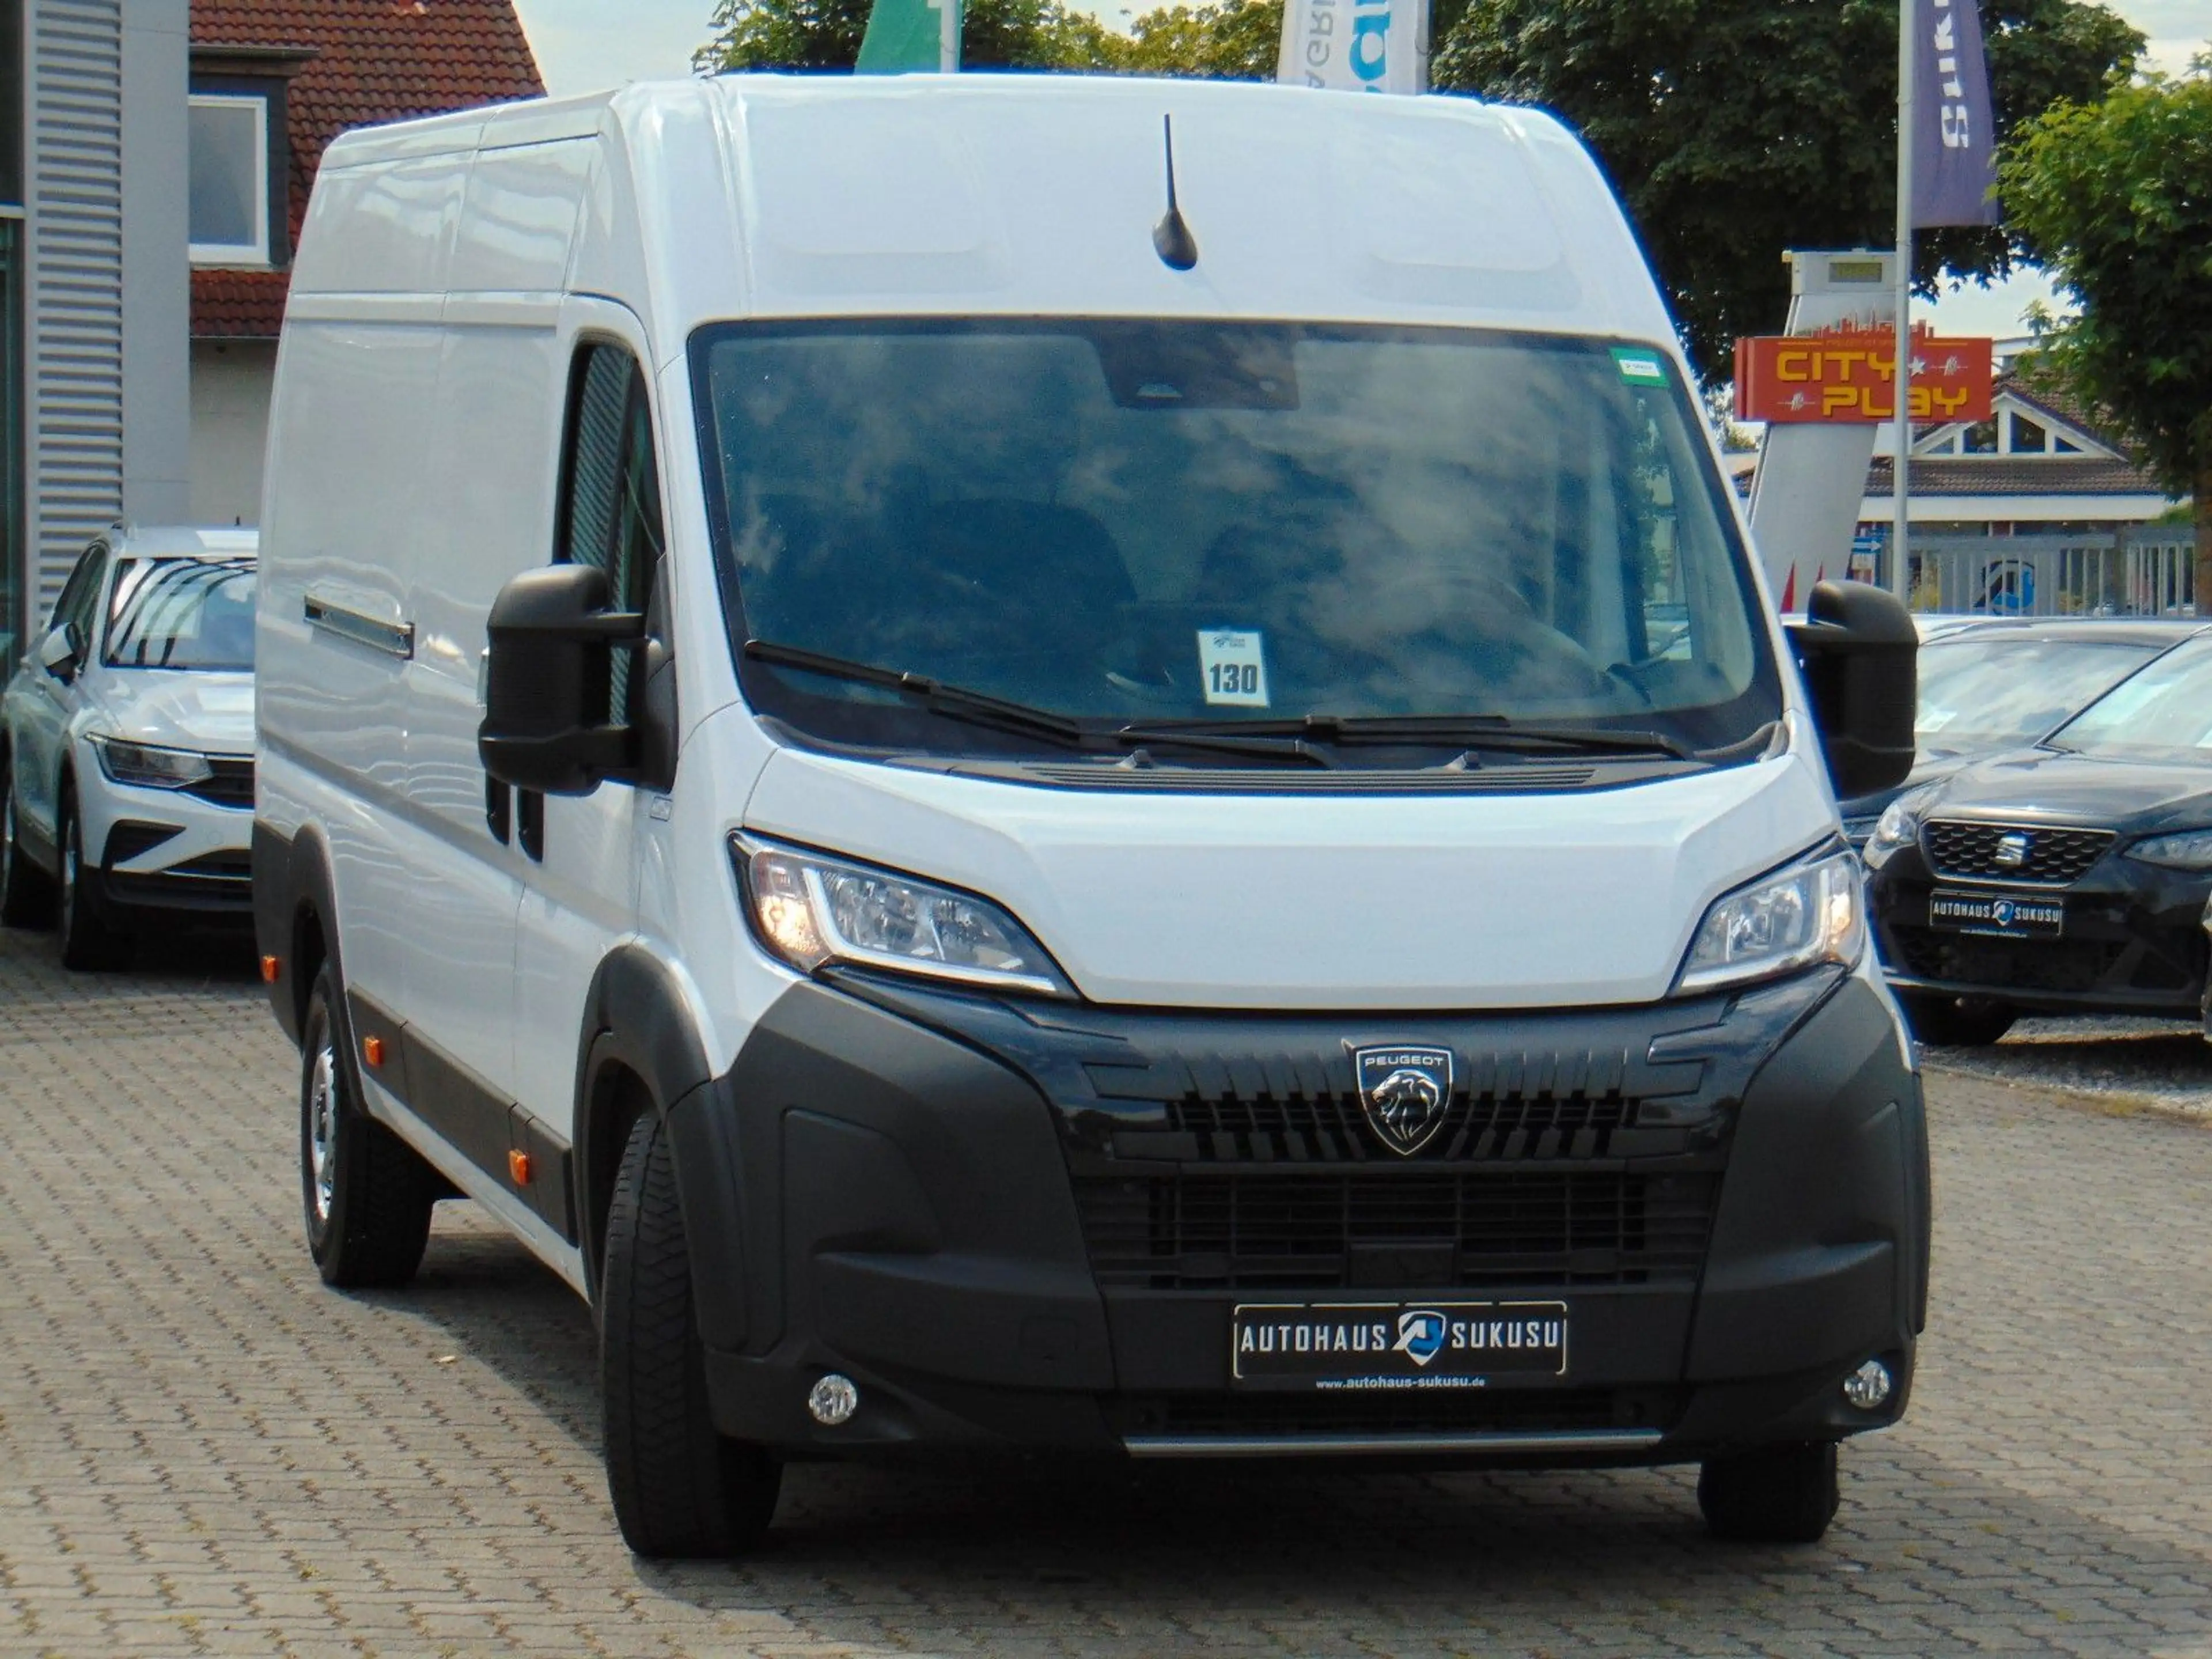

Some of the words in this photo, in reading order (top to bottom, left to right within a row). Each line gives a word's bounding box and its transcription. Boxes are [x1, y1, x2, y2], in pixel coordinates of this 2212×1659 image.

[1776, 351, 1899, 382] CITY
[1821, 387, 1968, 418] PLAY
[1210, 663, 1257, 694] 130
[1933, 901, 1990, 918] AUTOHAUS
[2014, 906, 2059, 922] SUKUSU
[1365, 1055, 1444, 1066] PEUGEOT
[1240, 1325, 1386, 1351] AUTOHAUS
[1452, 1321, 1558, 1349] SUKUSU
[1316, 1376, 1486, 1389] www.autohaus-sukusu.de
